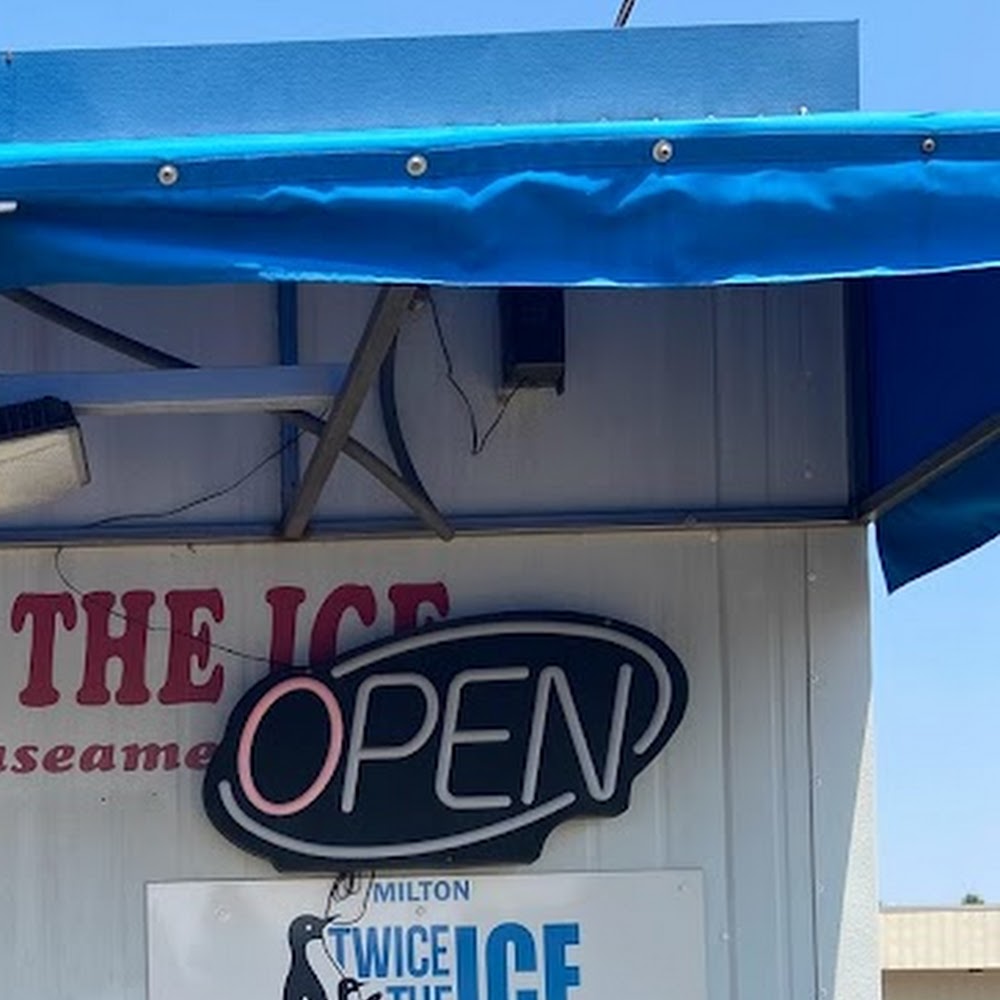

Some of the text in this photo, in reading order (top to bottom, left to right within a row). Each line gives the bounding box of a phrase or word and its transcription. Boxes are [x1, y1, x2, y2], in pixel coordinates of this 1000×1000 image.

[10, 587, 225, 708] THE
[237, 664, 634, 817] OPEN
[372, 880, 470, 903] MILTON
[328, 925, 451, 979] TWICE
